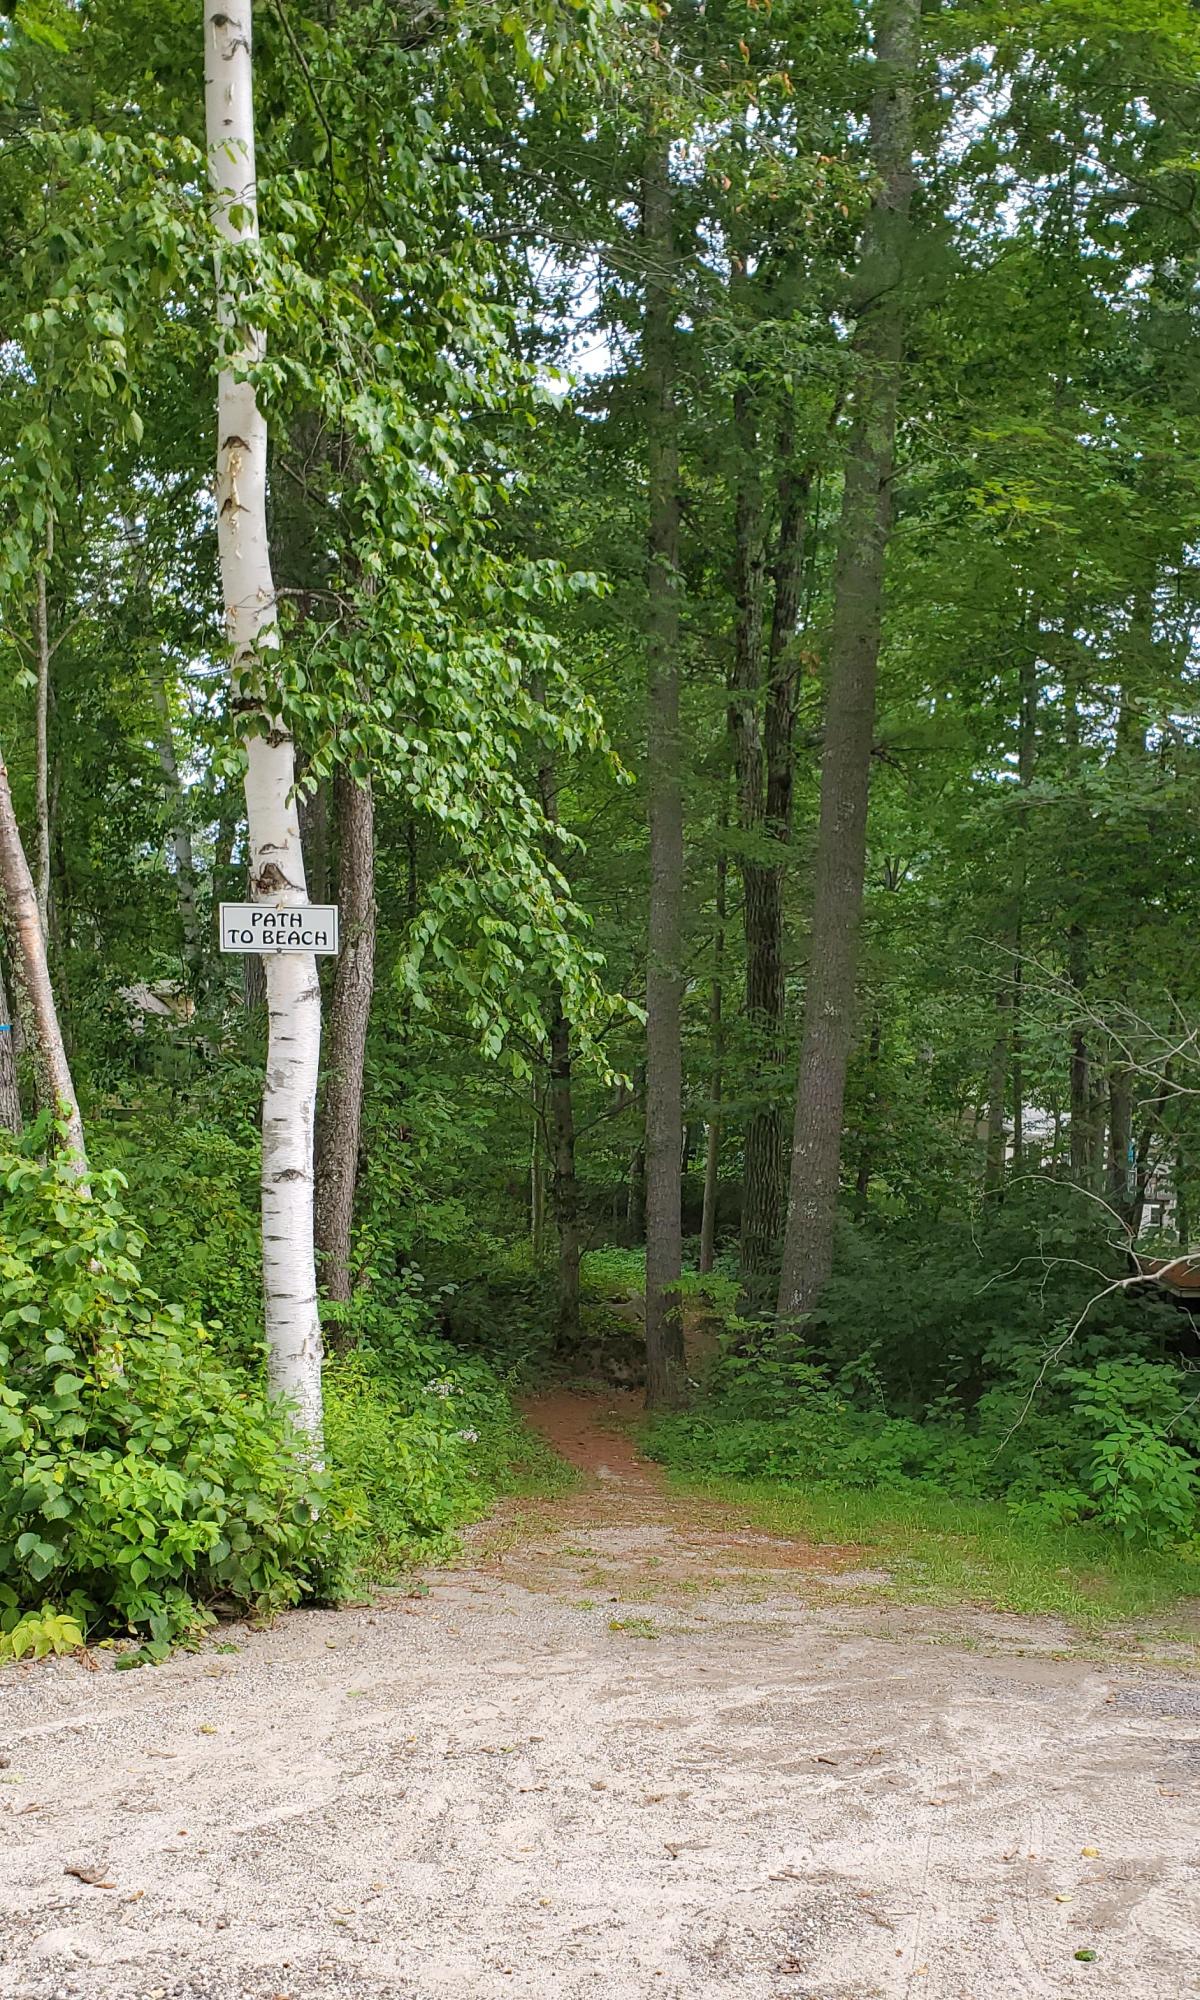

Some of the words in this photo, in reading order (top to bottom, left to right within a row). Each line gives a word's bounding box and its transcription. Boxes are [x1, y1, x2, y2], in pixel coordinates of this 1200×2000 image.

[251, 912, 303, 928] PATH
[227, 929, 254, 944] TO
[262, 930, 328, 946] BEACH
